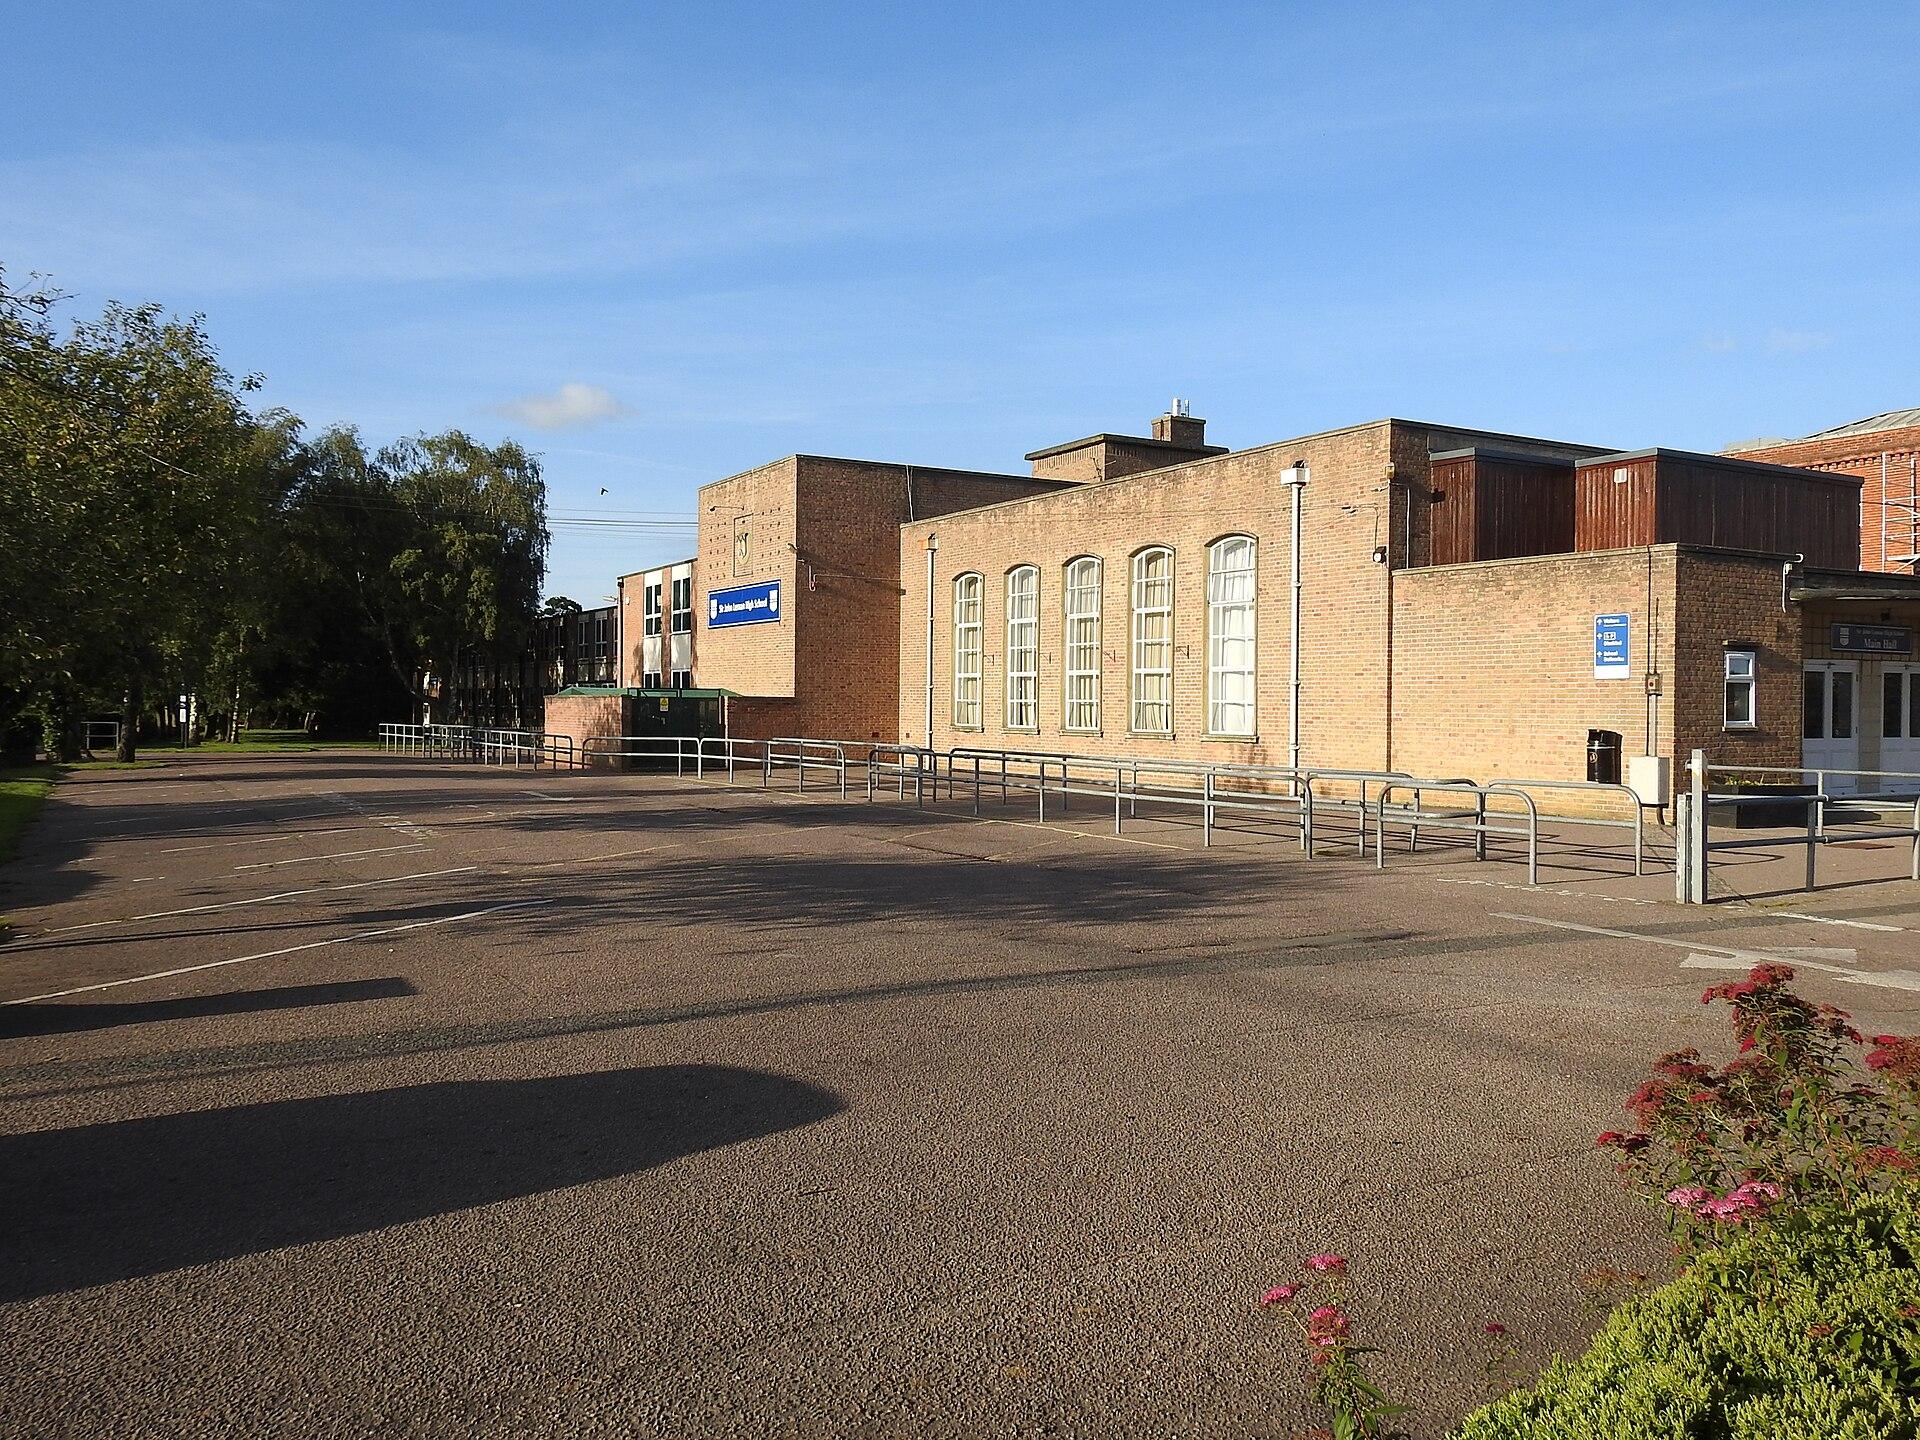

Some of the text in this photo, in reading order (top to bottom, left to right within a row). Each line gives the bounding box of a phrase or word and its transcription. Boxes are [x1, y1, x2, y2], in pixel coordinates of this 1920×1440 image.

[746, 600, 754, 612] High
[754, 598, 768, 608] School
[1864, 638, 1897, 649] Main Hall
